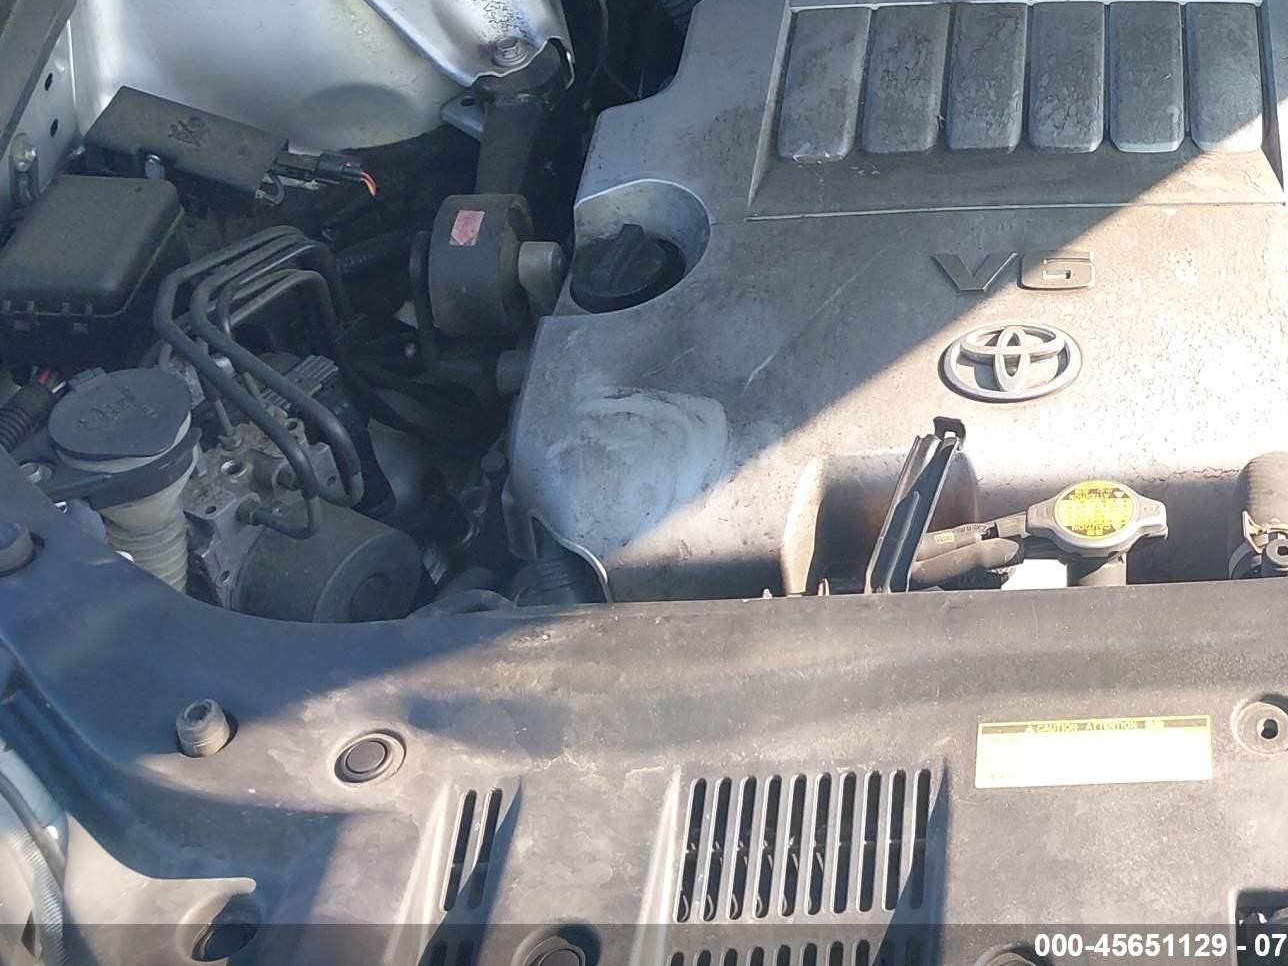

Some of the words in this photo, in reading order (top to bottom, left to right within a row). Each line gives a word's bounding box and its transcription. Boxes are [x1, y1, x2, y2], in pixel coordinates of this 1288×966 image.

[930, 250, 1096, 292] V6
[1036, 722, 1078, 733] CAUTION
[1086, 720, 1137, 731] ATTENTION
